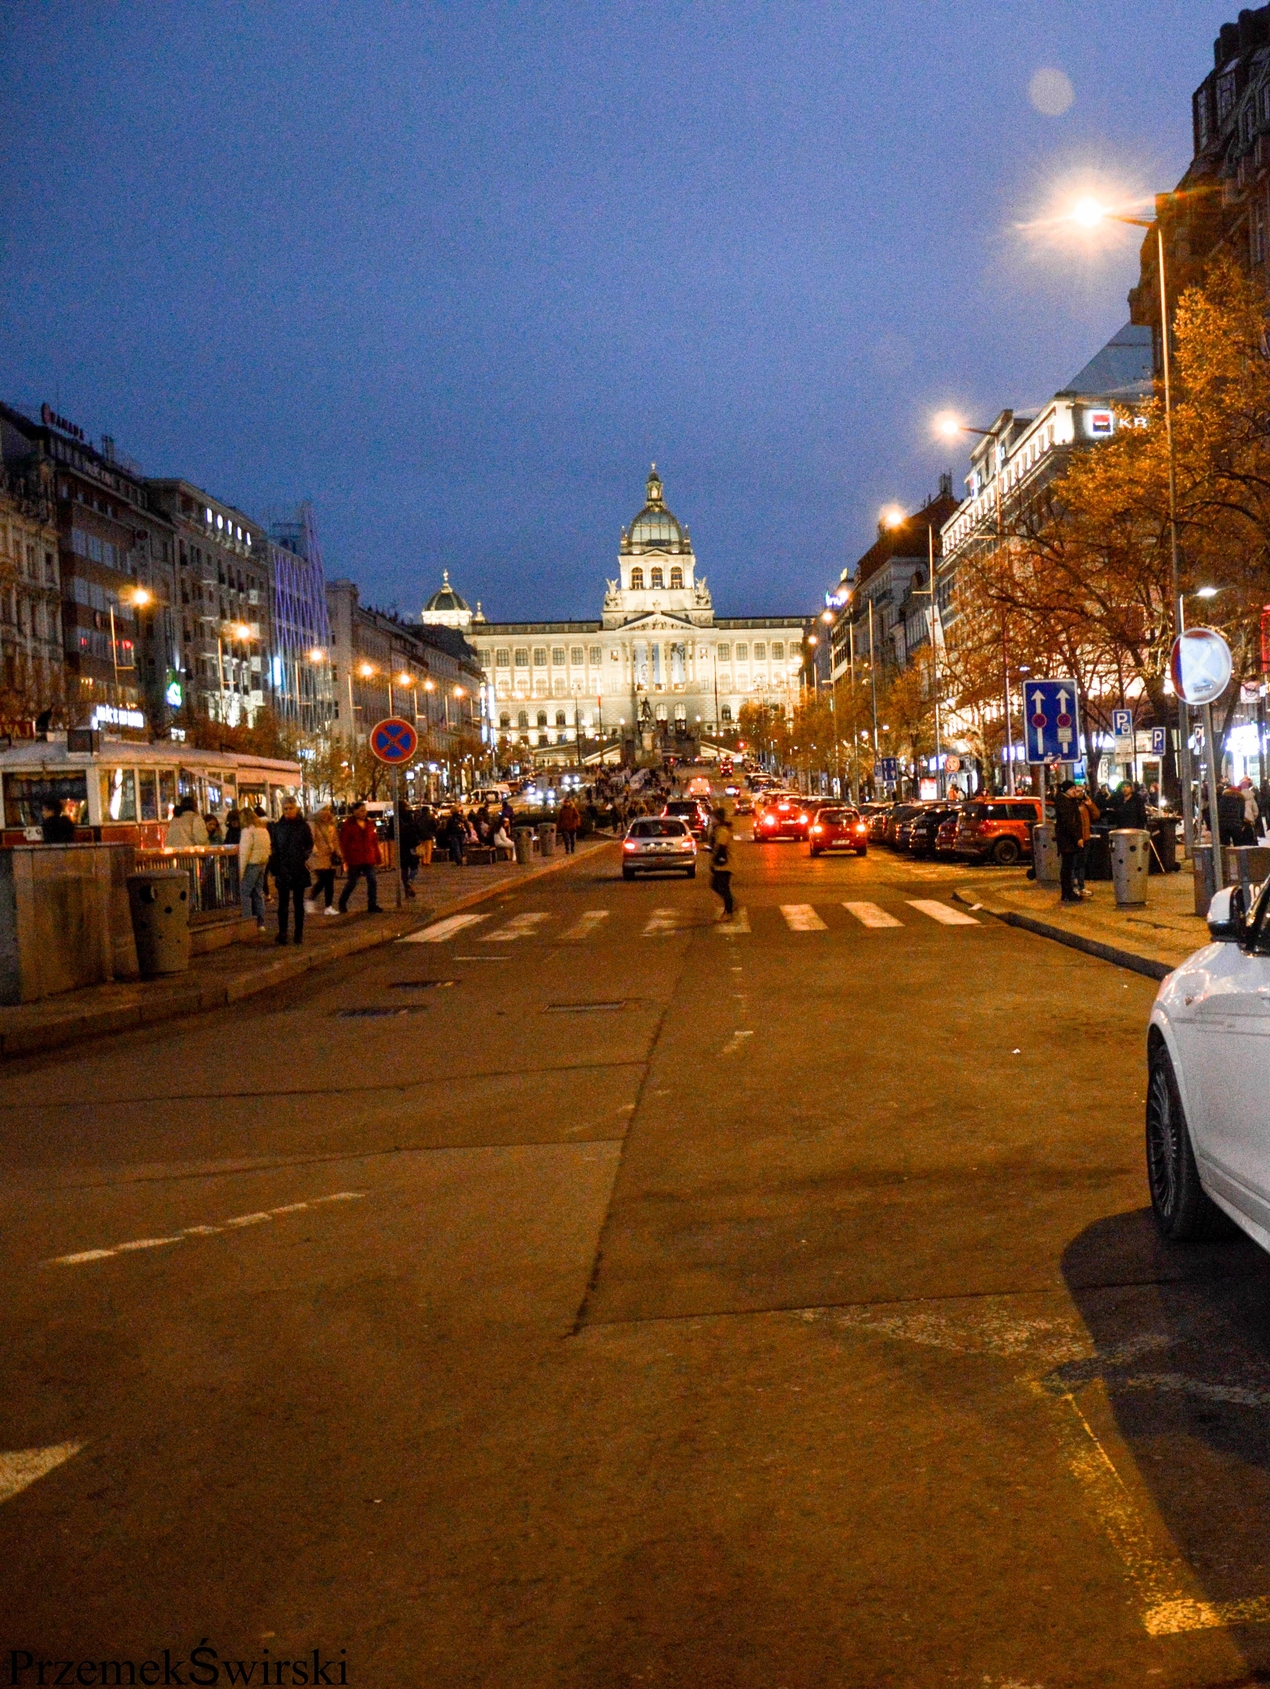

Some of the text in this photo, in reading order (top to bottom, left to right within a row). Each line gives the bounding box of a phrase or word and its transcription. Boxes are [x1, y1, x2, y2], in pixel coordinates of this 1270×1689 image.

[1118, 416, 1148, 429] KB
[1117, 712, 1129, 729] P
[1154, 729, 1163, 747] P
